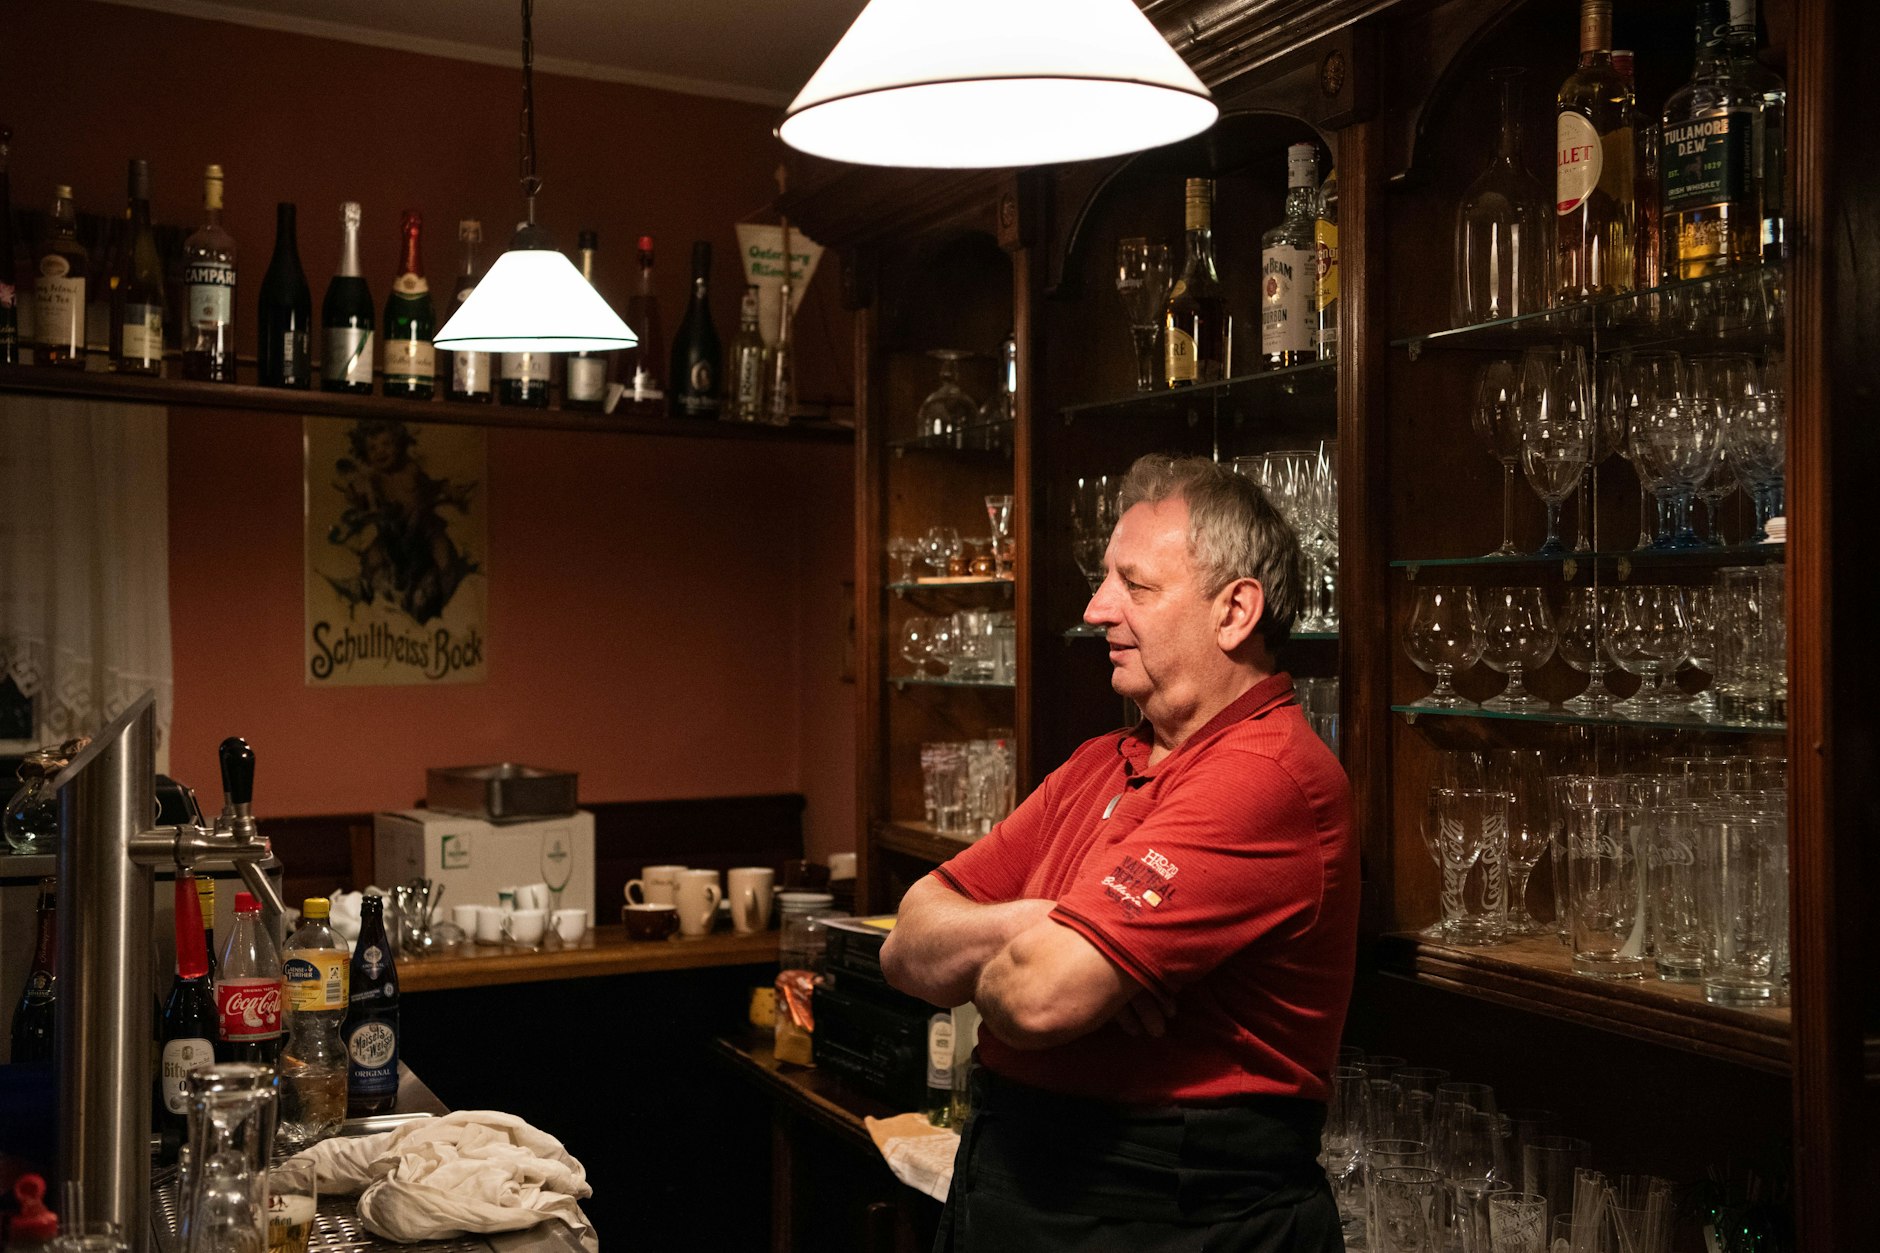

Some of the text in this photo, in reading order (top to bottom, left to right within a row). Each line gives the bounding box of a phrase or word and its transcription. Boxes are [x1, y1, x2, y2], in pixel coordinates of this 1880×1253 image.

[1664, 118, 1729, 146] TULLAMORE
[1678, 138, 1708, 157] D.E.W.
[1703, 161, 1722, 171] 1829
[1686, 180, 1722, 193] WHISKEY
[184, 267, 237, 286] CAMPARI
[1269, 257, 1293, 281] BEAM
[424, 628, 484, 680] Bock
[354, 1069, 392, 1078] ORIGINAL
